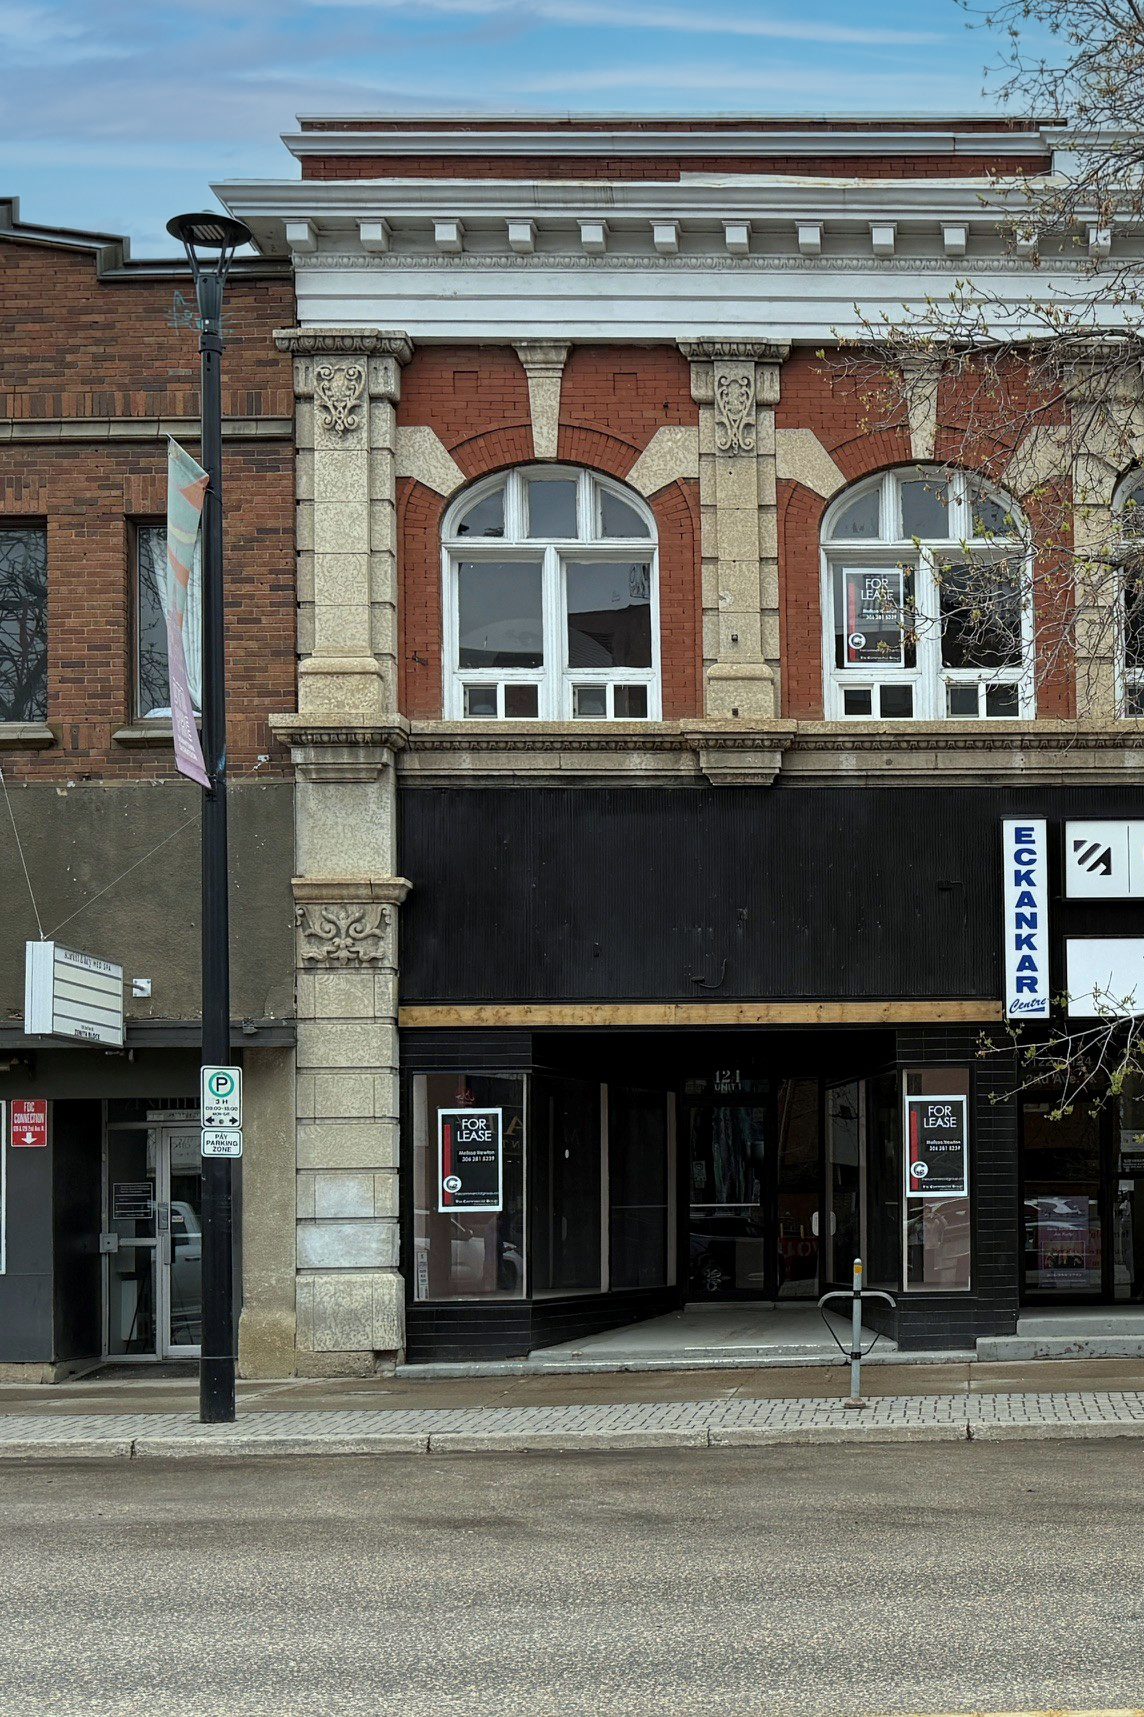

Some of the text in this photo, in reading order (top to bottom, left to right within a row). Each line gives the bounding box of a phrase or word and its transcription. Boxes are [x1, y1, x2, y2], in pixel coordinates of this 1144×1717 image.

[865, 578, 889, 589] FOR
[861, 589, 894, 600] LEASE
[1013, 827, 1039, 993] ECKANKAR
[1009, 998, 1047, 1014] Centre
[928, 1105, 952, 1117] FOR
[461, 1119, 487, 1130] FOR
[923, 1116, 957, 1128] LEASE
[457, 1130, 492, 1142] LEASE
